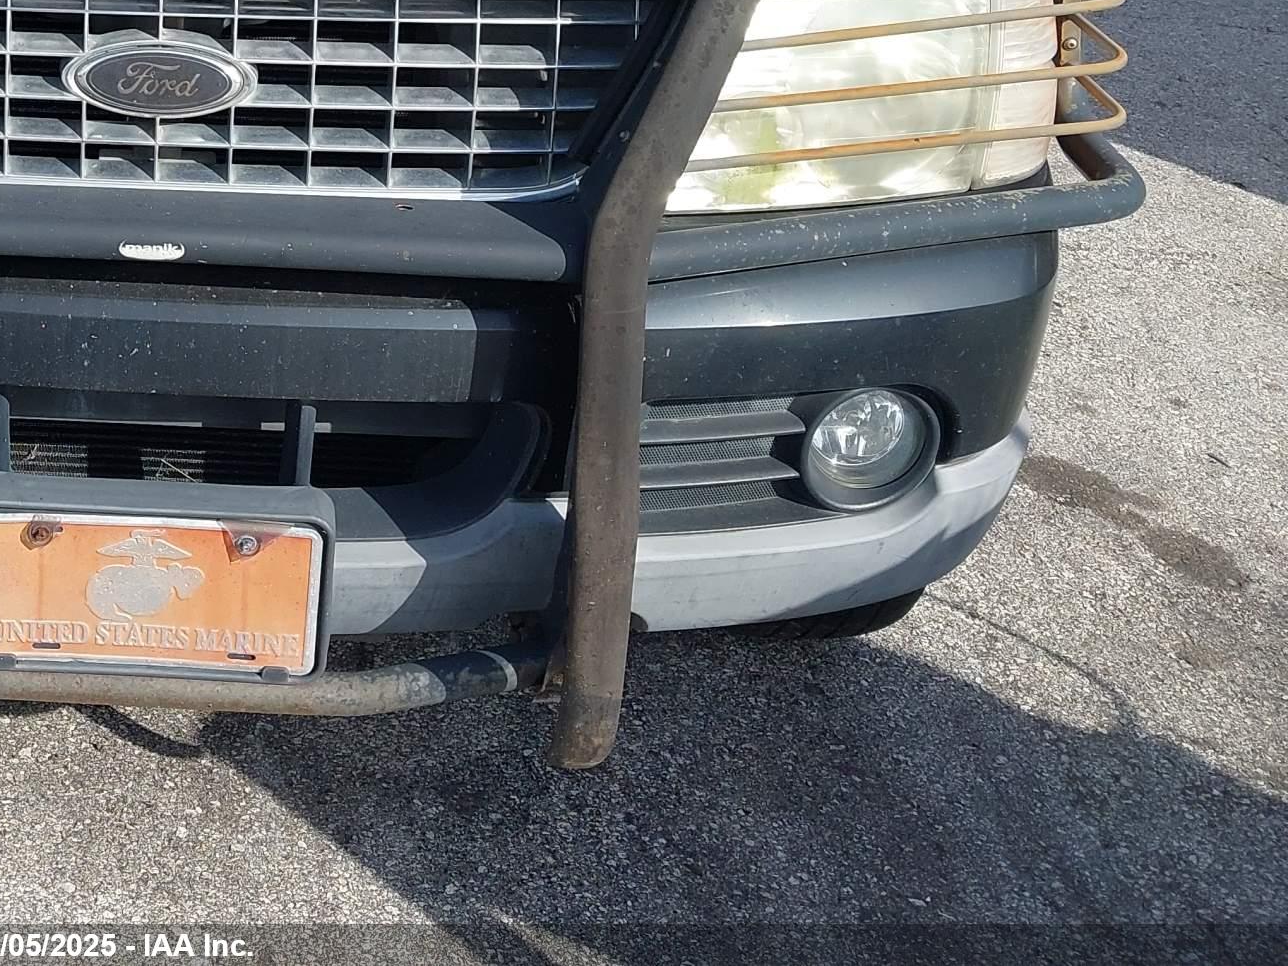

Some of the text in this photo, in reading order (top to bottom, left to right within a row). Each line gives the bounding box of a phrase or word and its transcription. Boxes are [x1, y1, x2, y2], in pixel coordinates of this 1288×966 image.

[117, 61, 201, 97] Ford
[95, 622, 191, 650] STATES
[194, 627, 300, 658] MARINE
